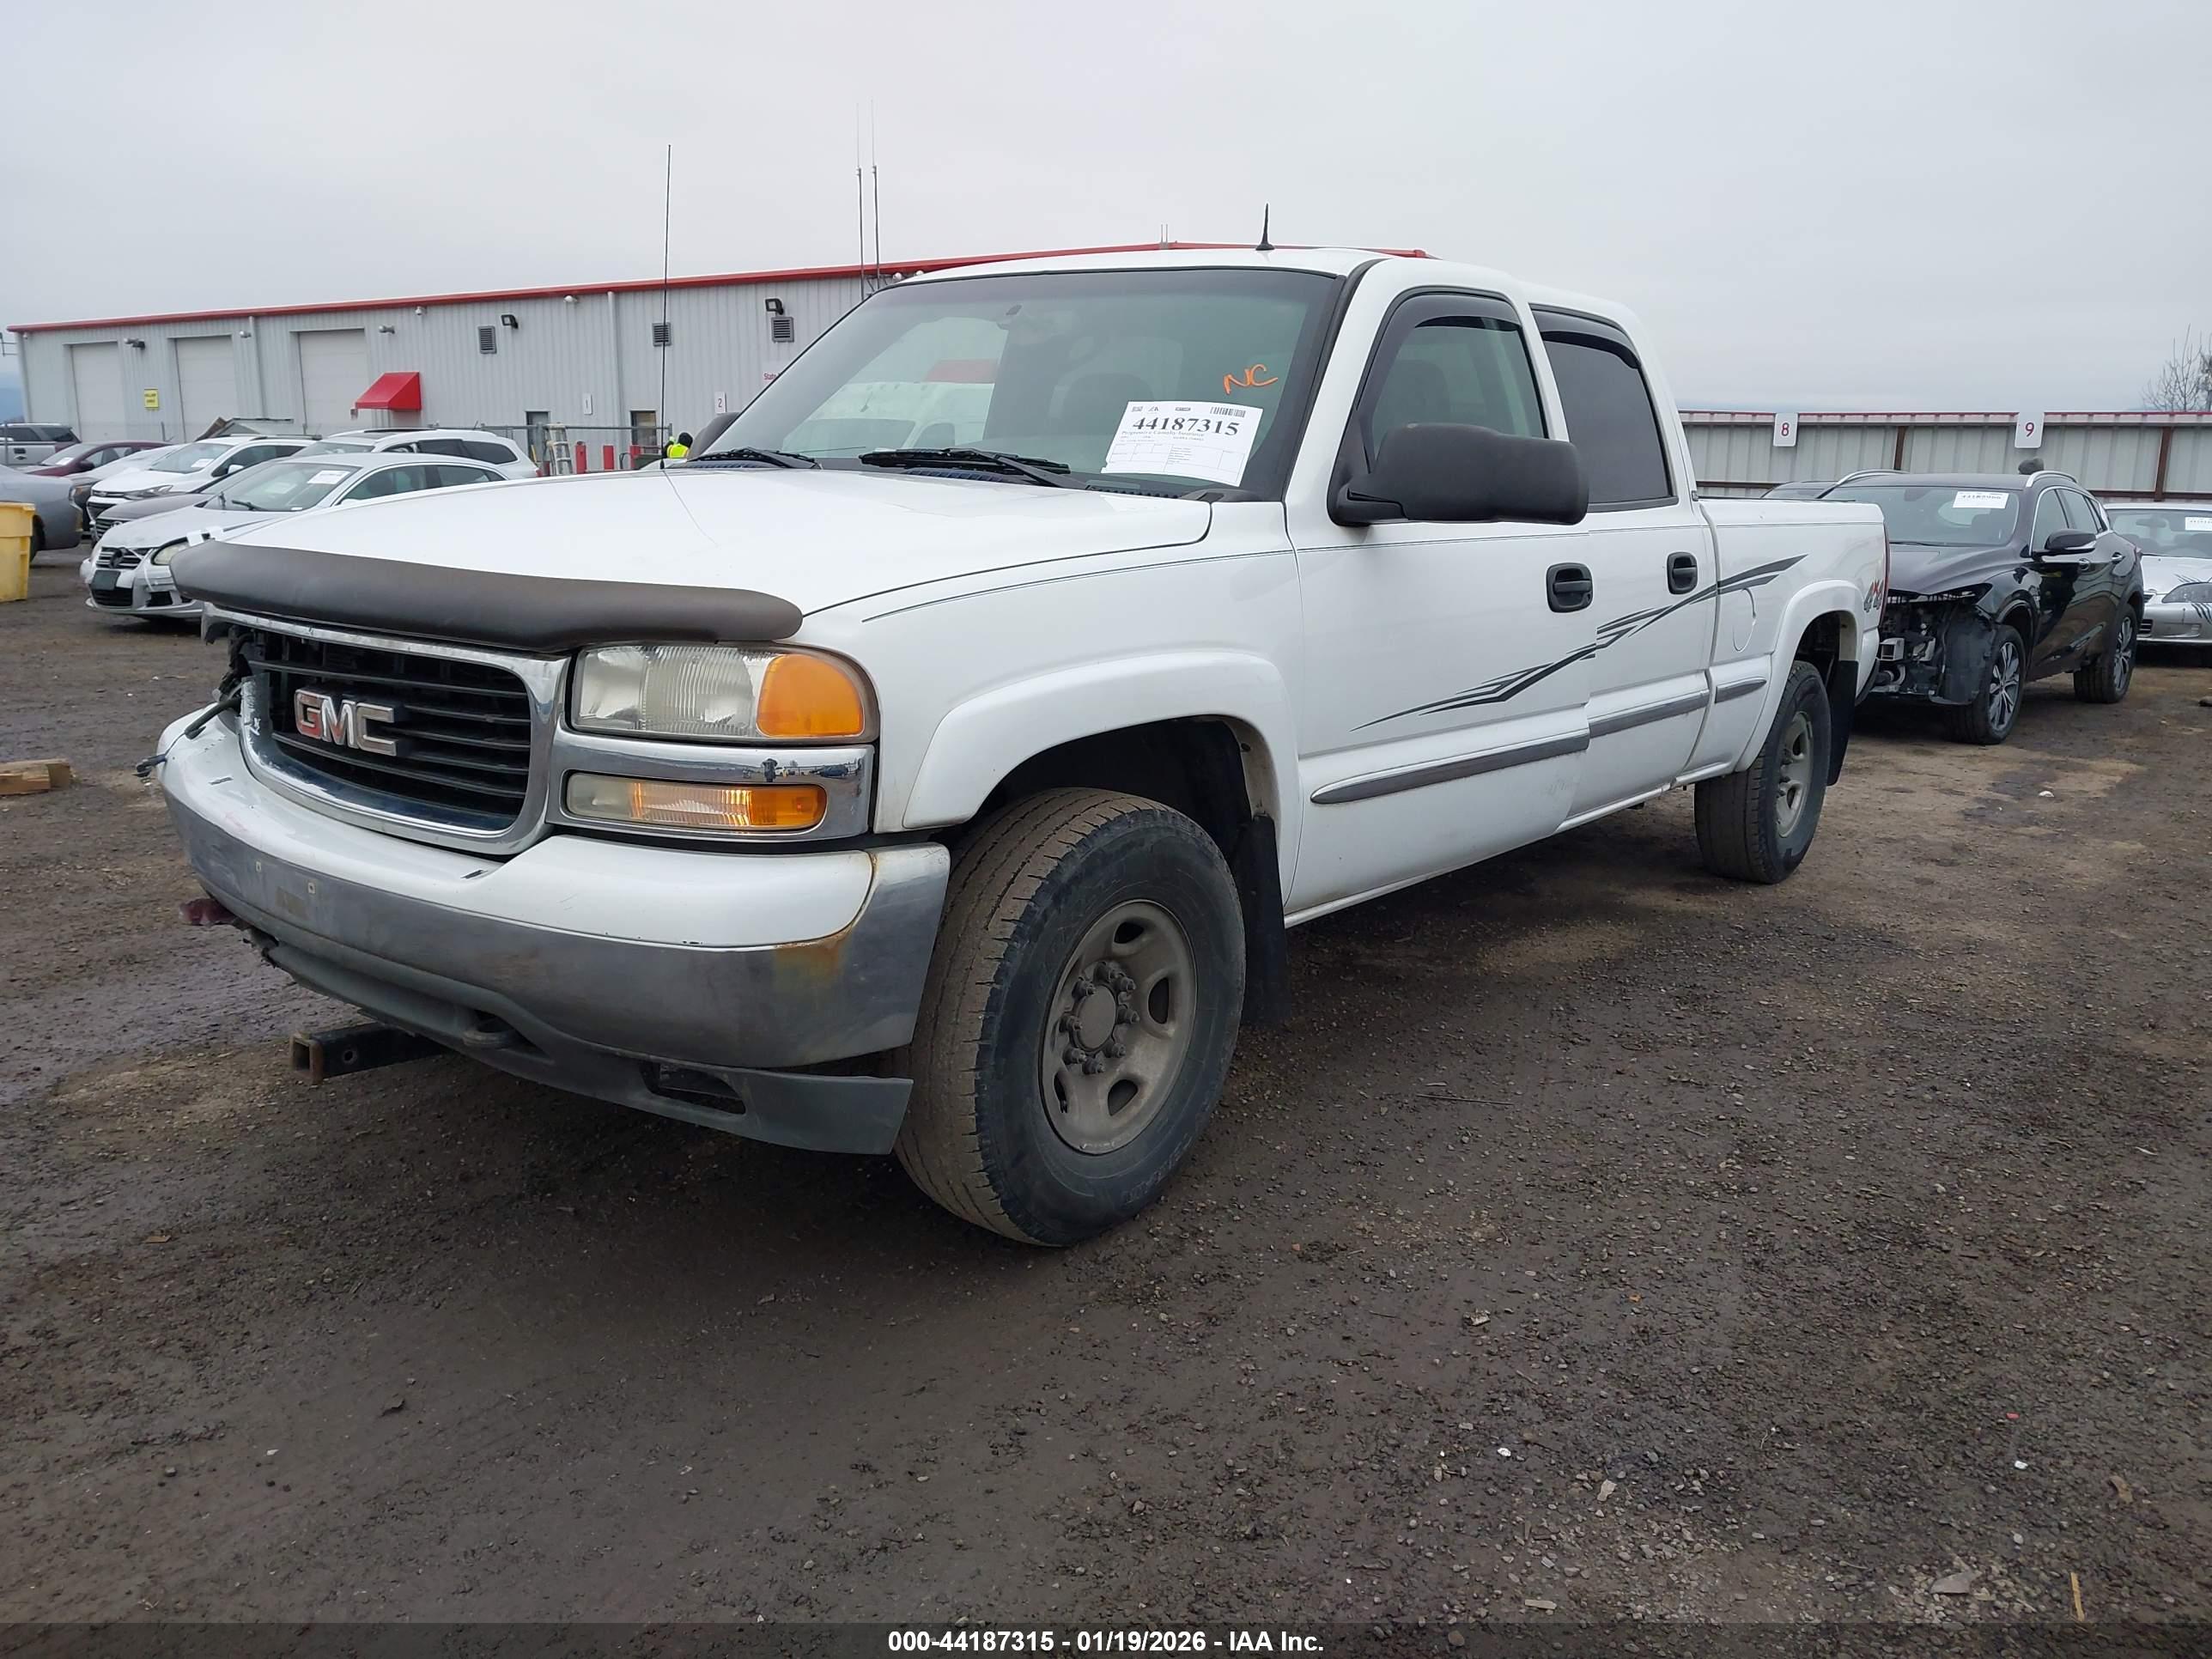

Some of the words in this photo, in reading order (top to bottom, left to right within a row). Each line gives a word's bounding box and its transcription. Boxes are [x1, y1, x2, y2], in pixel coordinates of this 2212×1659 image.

[1223, 363, 1279, 396] NC
[718, 398, 722, 408] 2
[1133, 416, 1240, 436] 44187315
[1781, 422, 1790, 436] 8
[2025, 422, 2035, 437] 9
[294, 689, 397, 757] GMC
